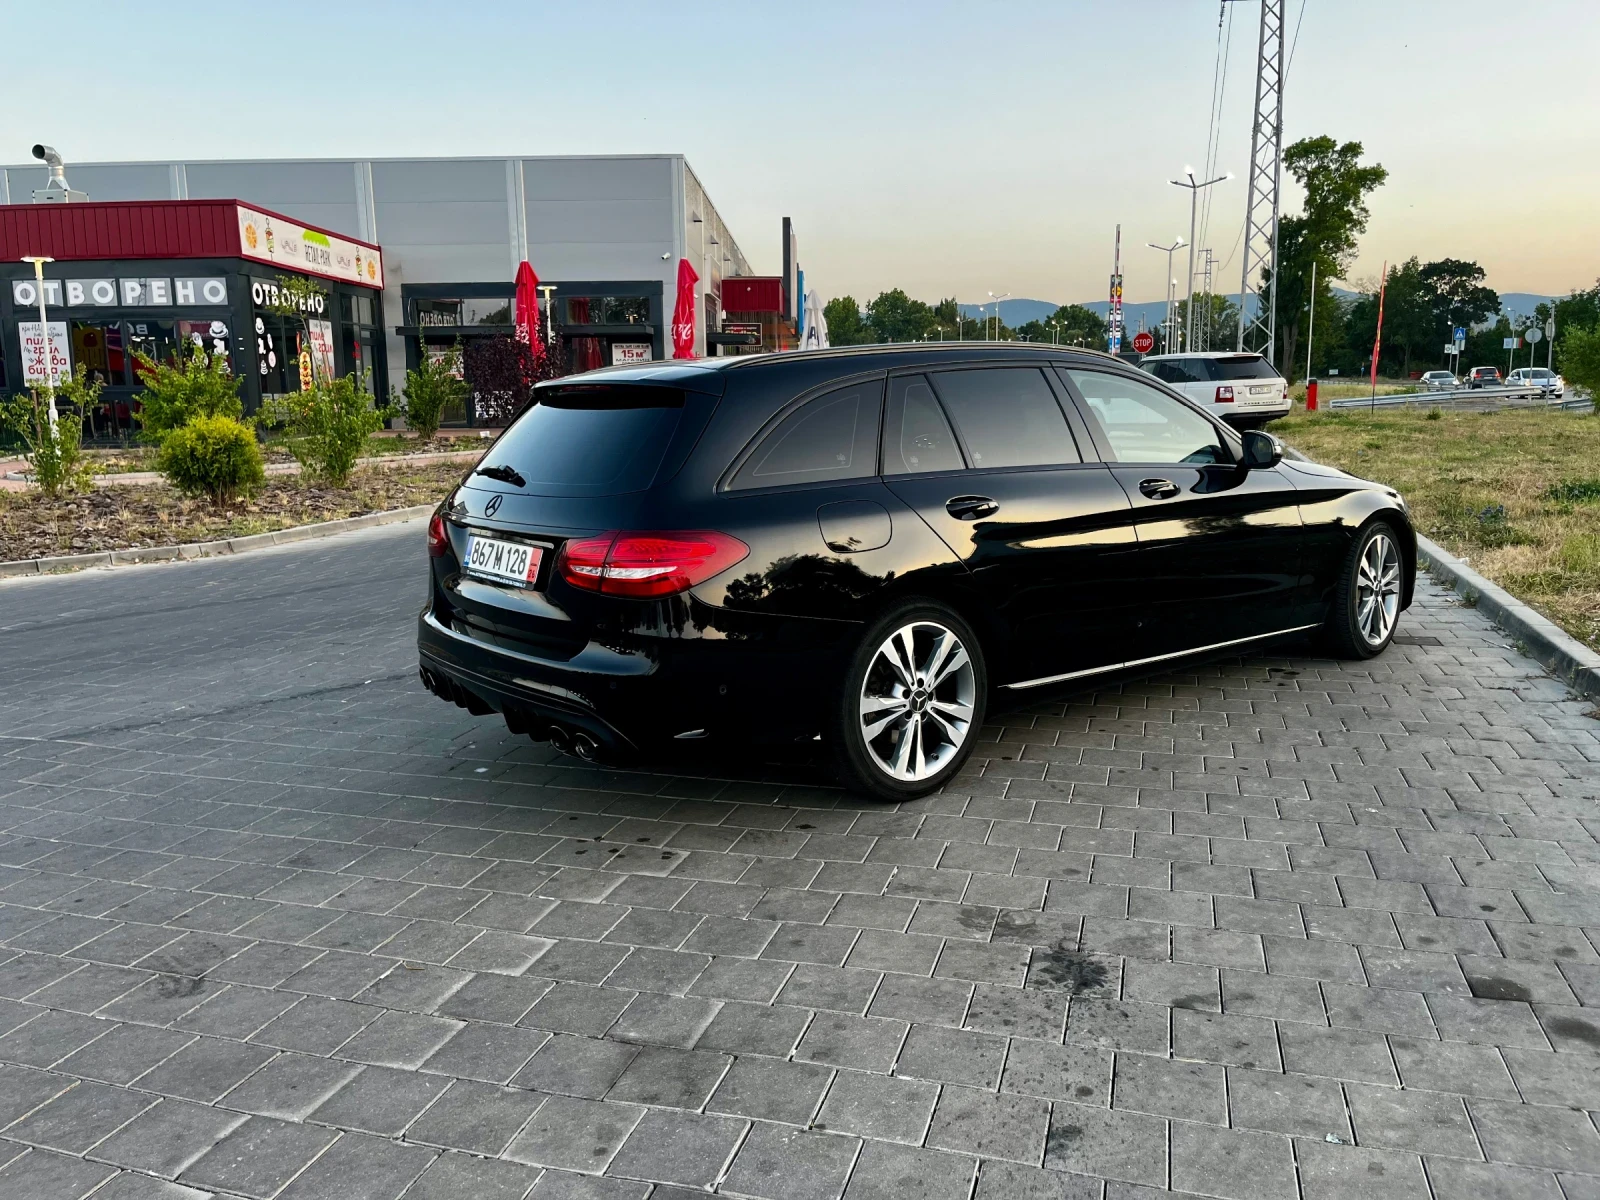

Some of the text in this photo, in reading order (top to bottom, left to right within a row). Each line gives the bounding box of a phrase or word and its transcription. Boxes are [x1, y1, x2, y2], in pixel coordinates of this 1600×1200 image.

[304, 244, 321, 265] RETAIL
[320, 249, 333, 268] PARK
[14, 280, 226, 305] ОТВОРЕНО
[1134, 338, 1151, 347] STOP
[34, 355, 67, 366] жва
[621, 349, 634, 358] 15
[471, 540, 528, 576] 867 M 128
